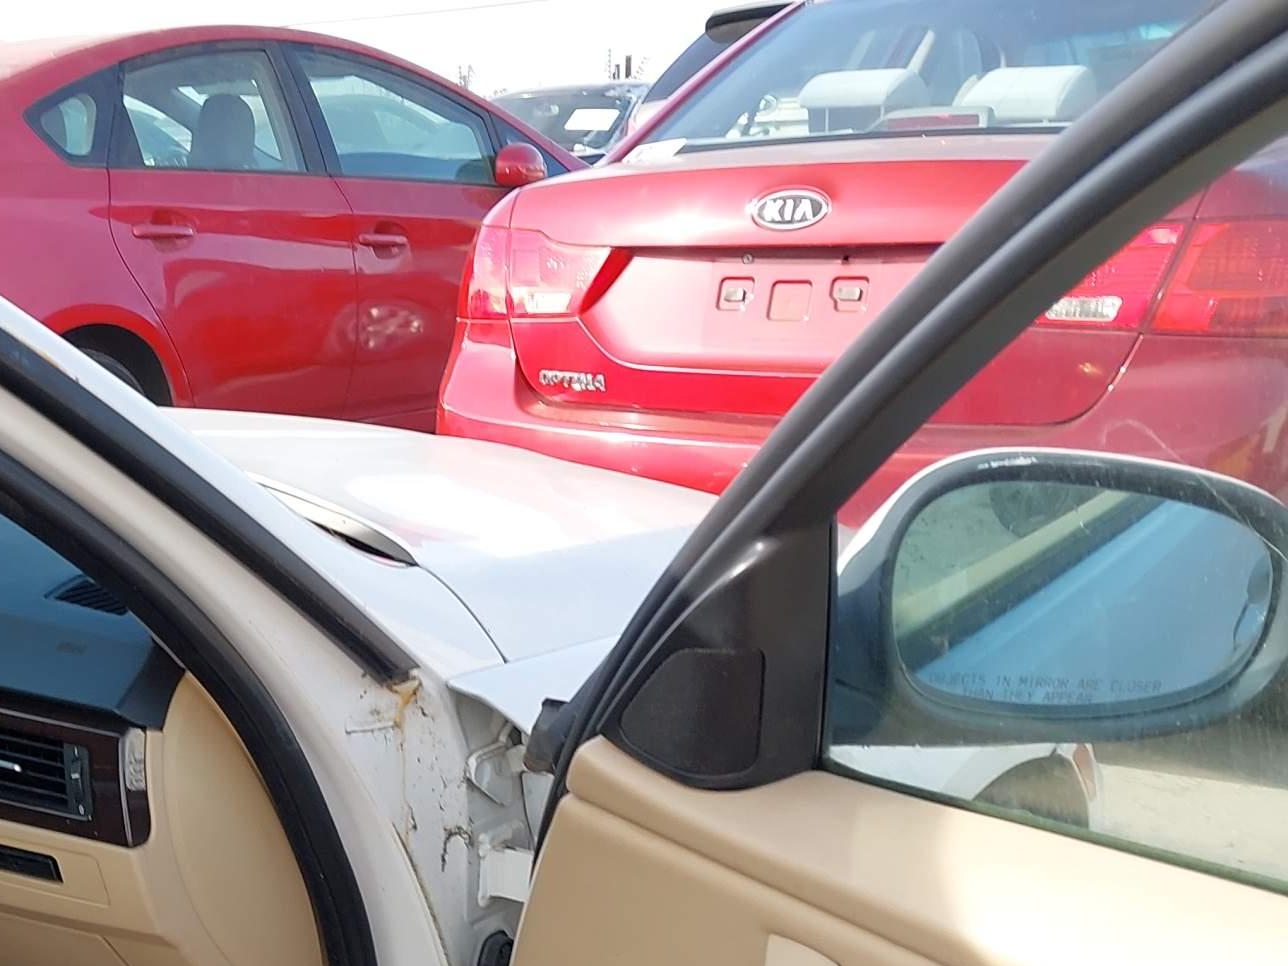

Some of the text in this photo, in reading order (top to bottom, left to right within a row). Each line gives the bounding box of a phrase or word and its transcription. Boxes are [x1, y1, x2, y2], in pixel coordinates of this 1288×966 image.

[763, 198, 813, 221] KIA
[539, 369, 606, 392] OPTIMA
[928, 671, 1162, 693] OBJECTS IN MIRROR ARE CLOSER
